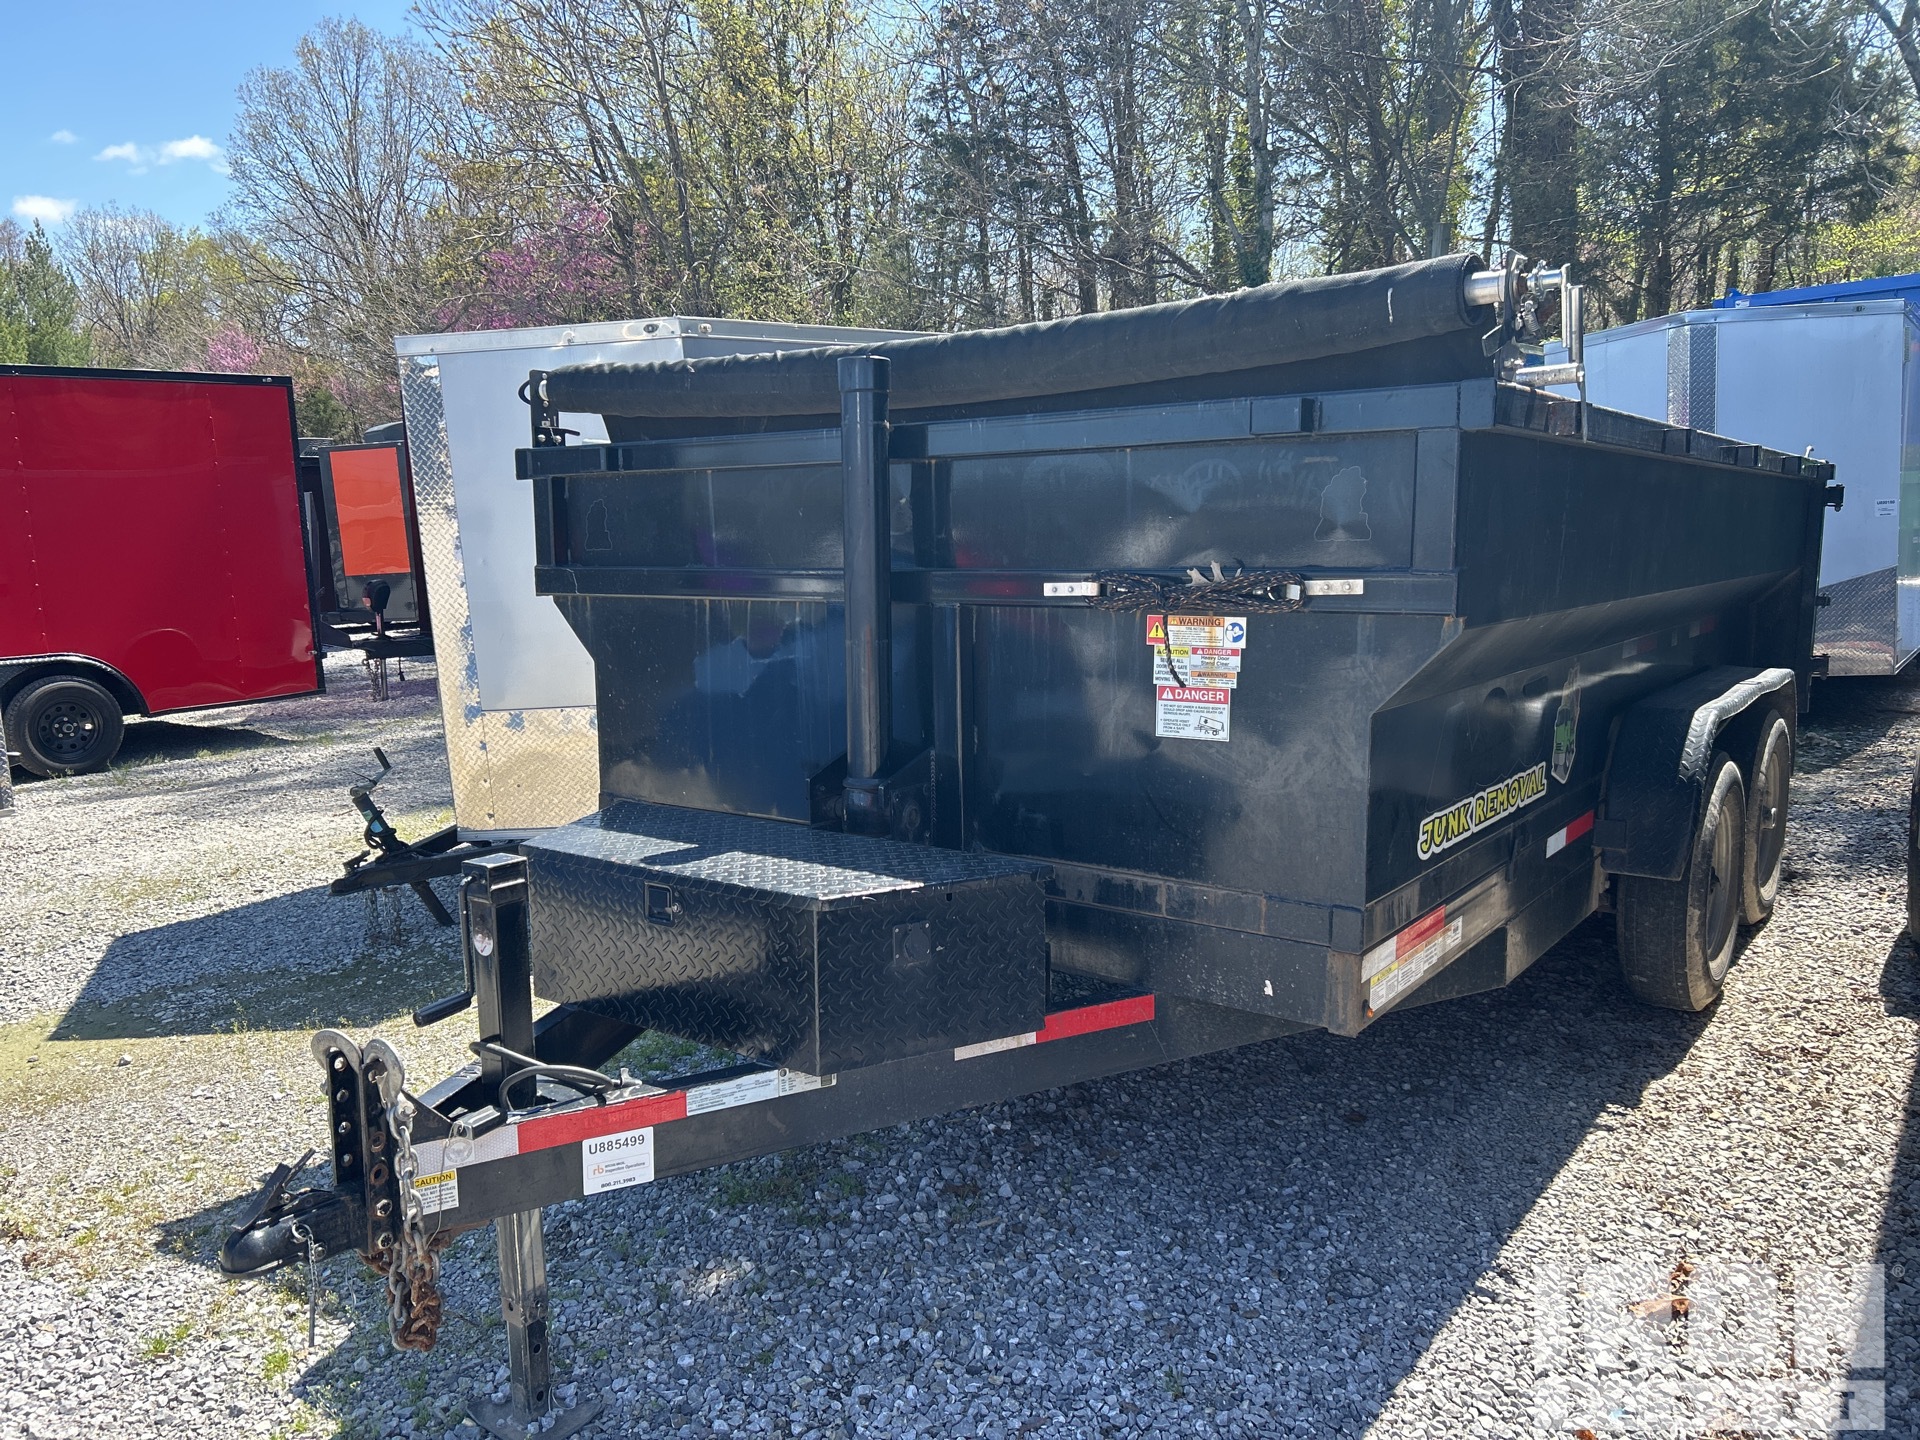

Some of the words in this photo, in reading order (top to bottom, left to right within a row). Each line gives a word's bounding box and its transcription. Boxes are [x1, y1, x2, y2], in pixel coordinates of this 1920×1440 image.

[1179, 617, 1221, 626] WARNING
[1175, 689, 1224, 702] DANGER
[1420, 802, 1472, 854] JUNK
[1474, 764, 1546, 827] REMOVAL
[588, 1134, 645, 1154] U885499
[415, 1173, 452, 1187] CAUTION
